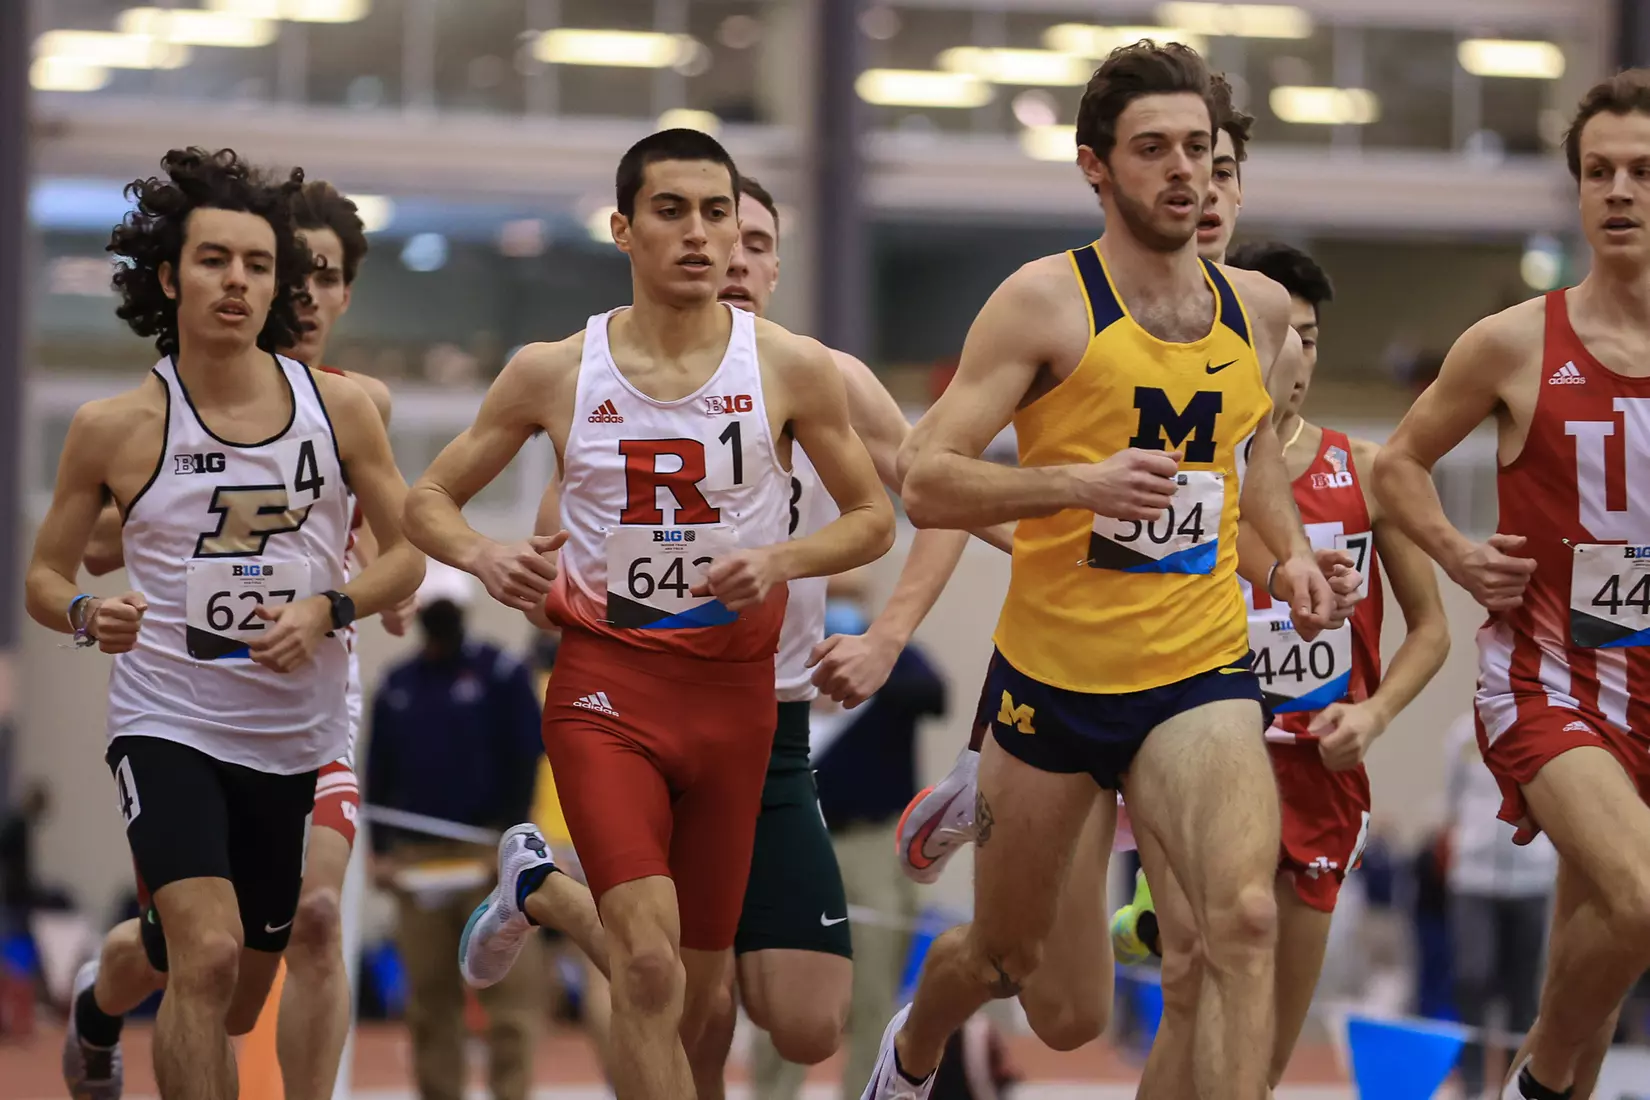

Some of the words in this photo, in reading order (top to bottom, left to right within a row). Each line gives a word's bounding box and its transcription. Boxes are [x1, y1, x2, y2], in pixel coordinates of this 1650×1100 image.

[1549, 376, 1586, 385] adidas
[588, 413, 624, 423] adidas
[1129, 386, 1222, 462] M
[294, 440, 325, 500] 4
[718, 421, 743, 485] 1
[618, 438, 720, 526] R
[1346, 537, 1368, 573] 7
[1252, 641, 1335, 685] 440
[573, 701, 620, 717] adidas
[997, 689, 1035, 735] M
